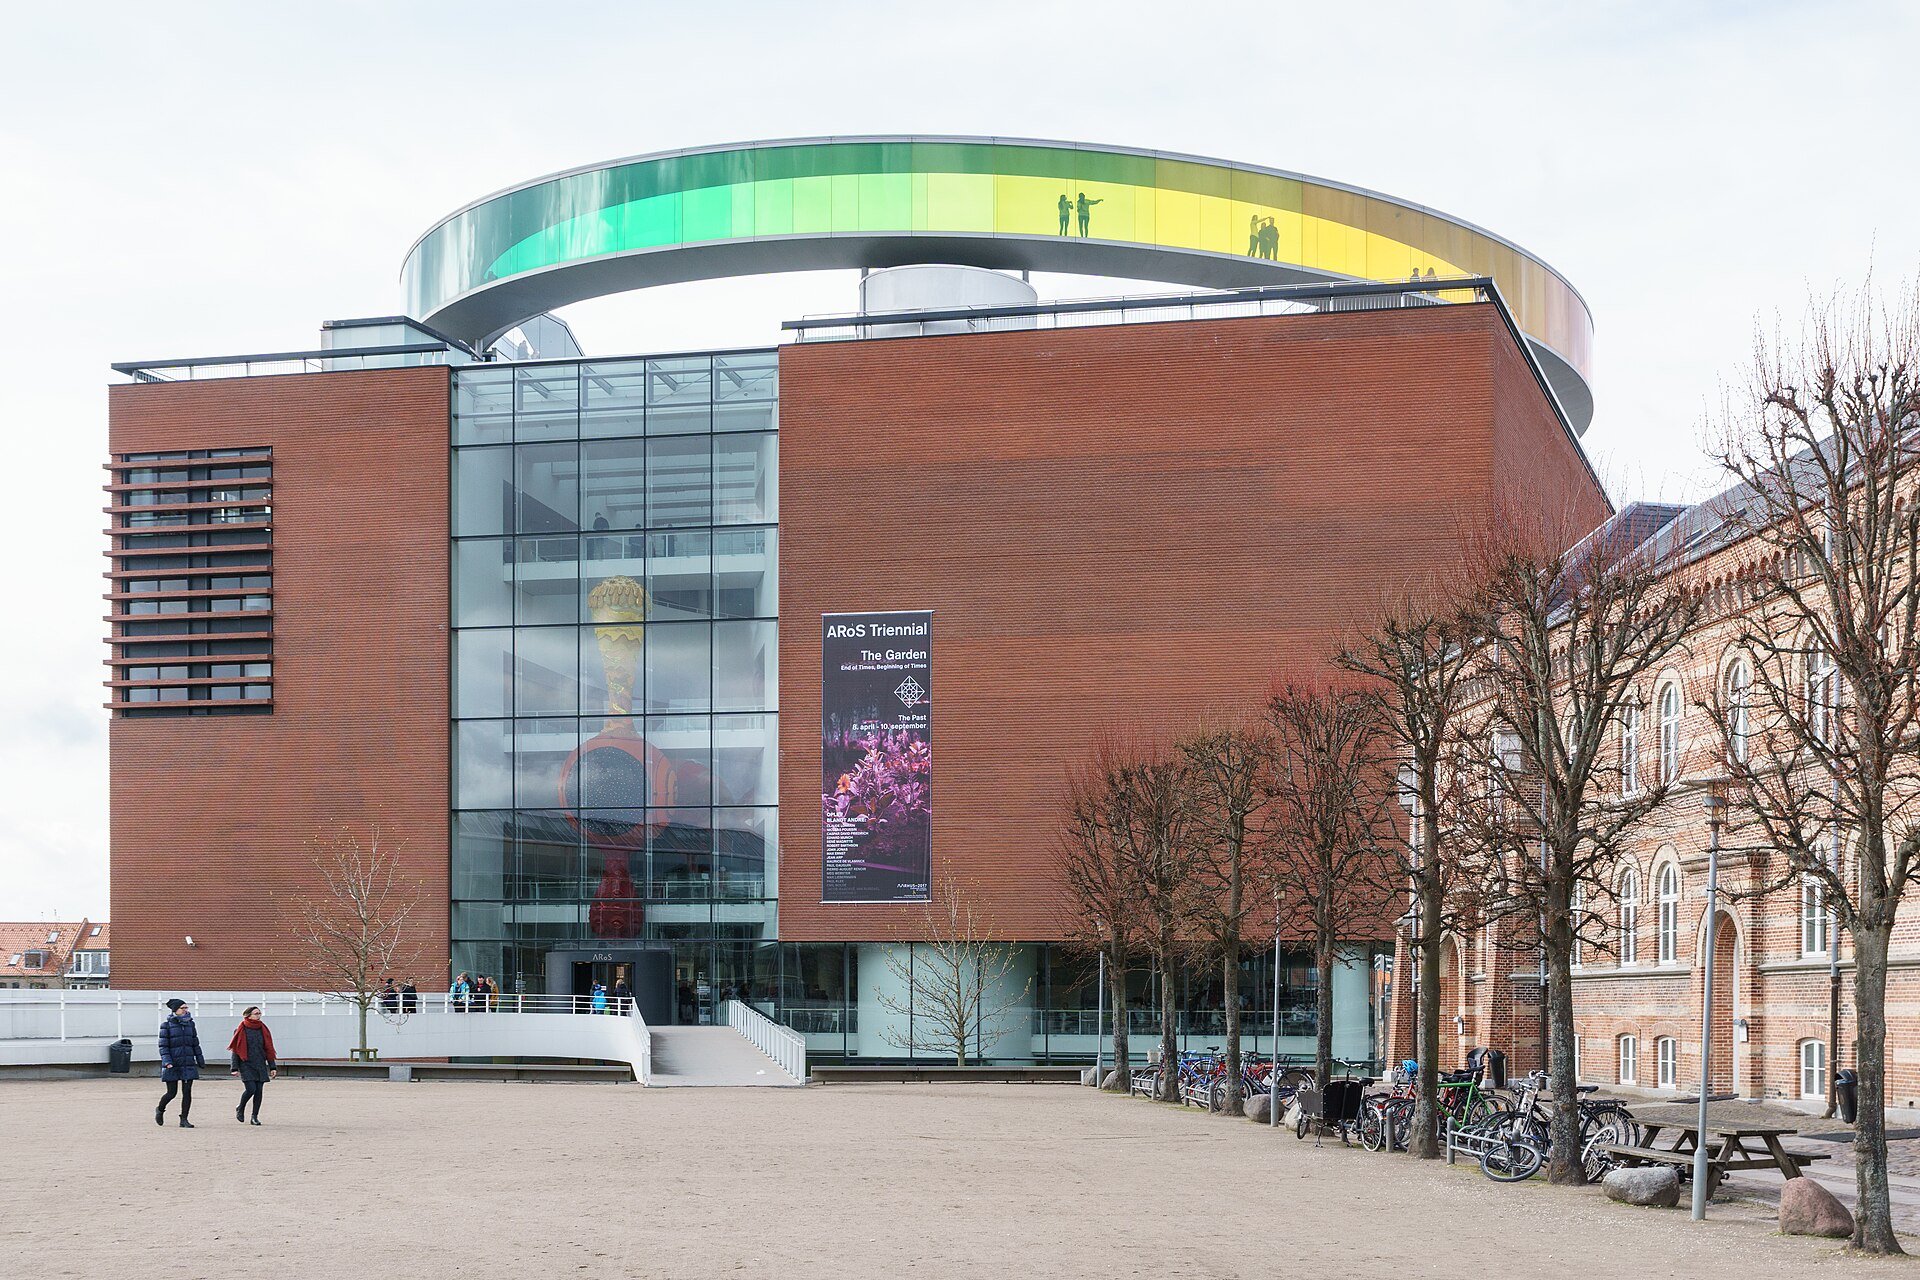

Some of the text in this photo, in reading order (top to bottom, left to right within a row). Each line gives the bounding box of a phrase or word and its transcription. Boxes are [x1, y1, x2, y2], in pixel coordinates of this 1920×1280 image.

[827, 622, 927, 638] ARoS Triennial
[861, 649, 926, 660] The Garden
